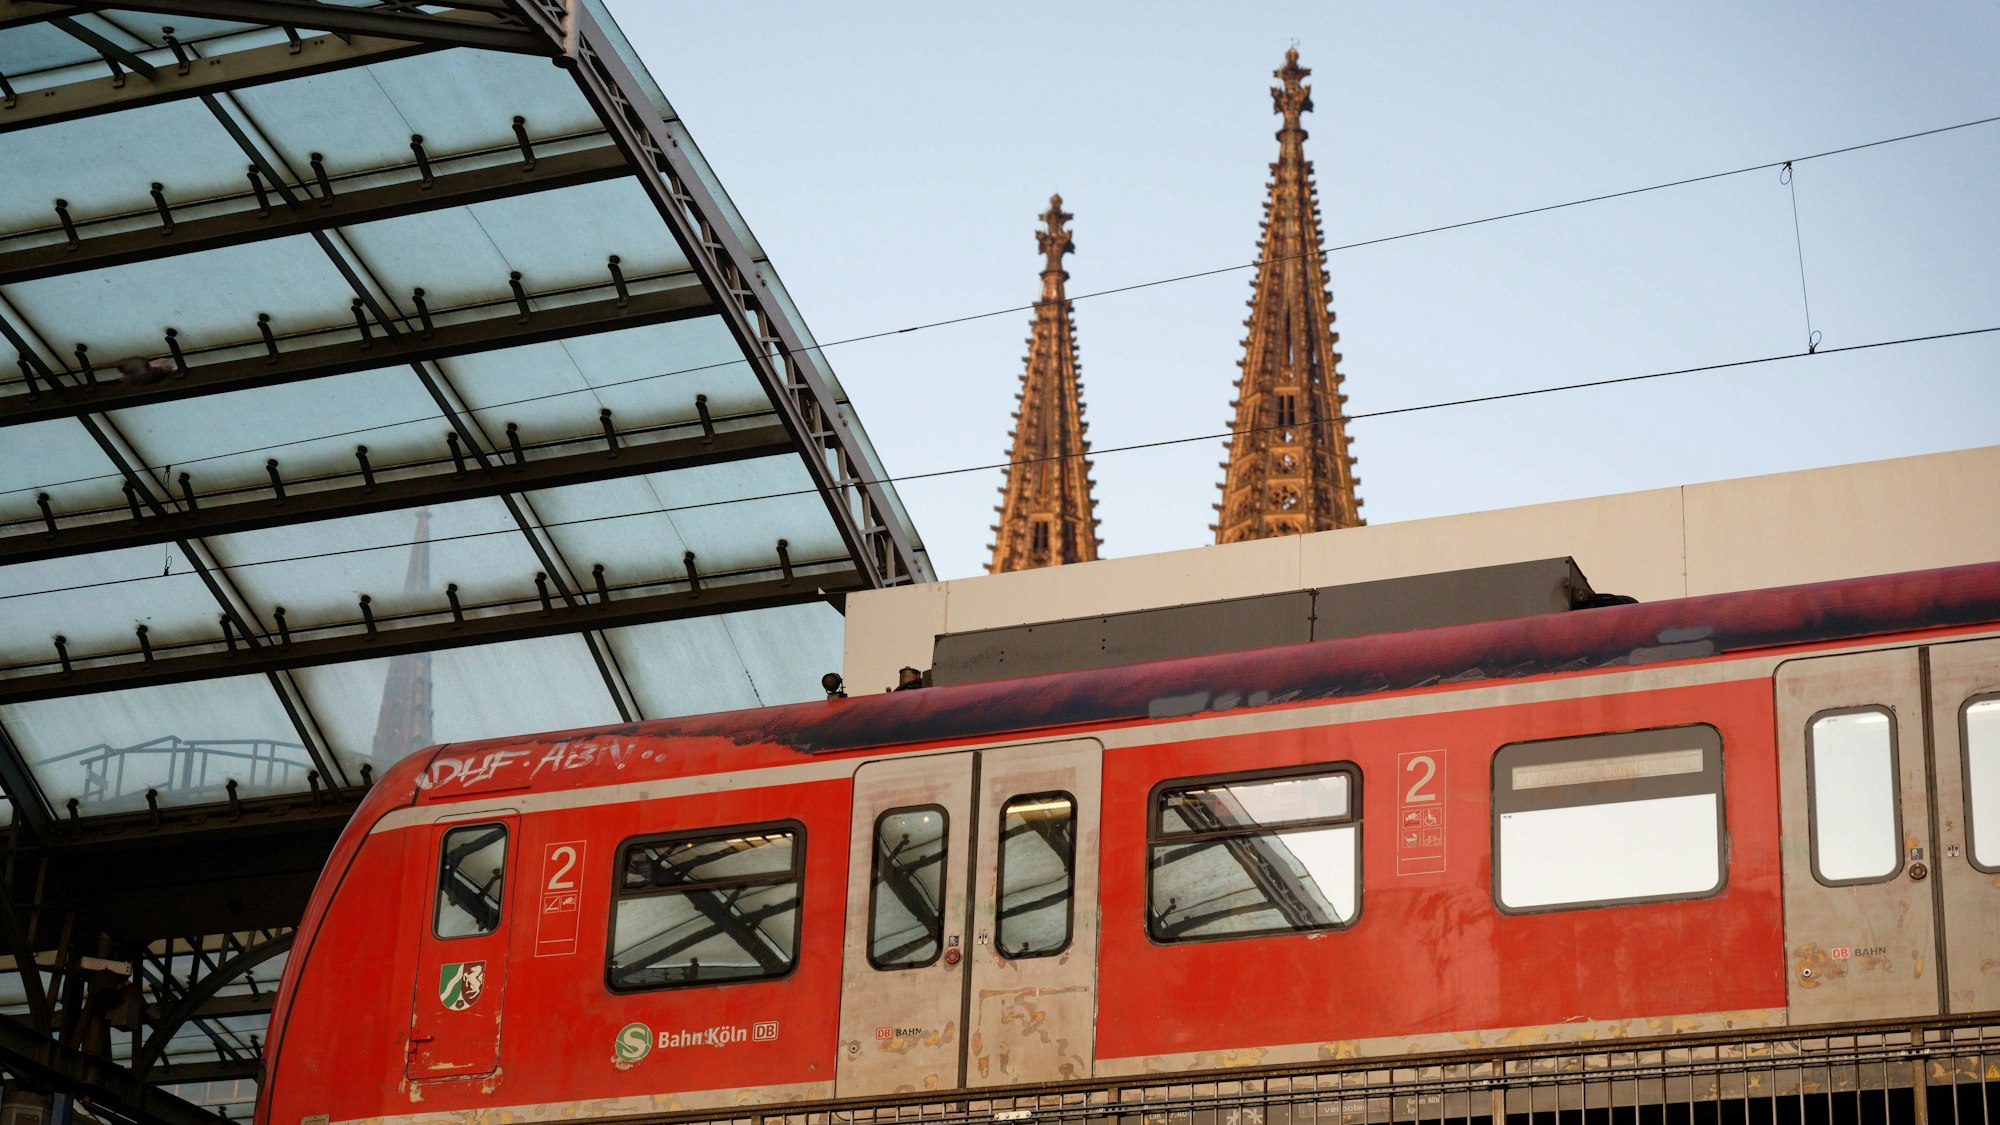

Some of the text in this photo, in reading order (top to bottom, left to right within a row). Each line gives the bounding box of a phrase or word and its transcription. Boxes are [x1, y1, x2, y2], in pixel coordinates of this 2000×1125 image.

[1405, 755, 1436, 803] 2
[548, 846, 576, 890] 2
[1832, 947, 1887, 960] DB BAHN
[621, 1023, 776, 1059] S Bahn Köln DB
[877, 1028, 922, 1039] DB BAHN
